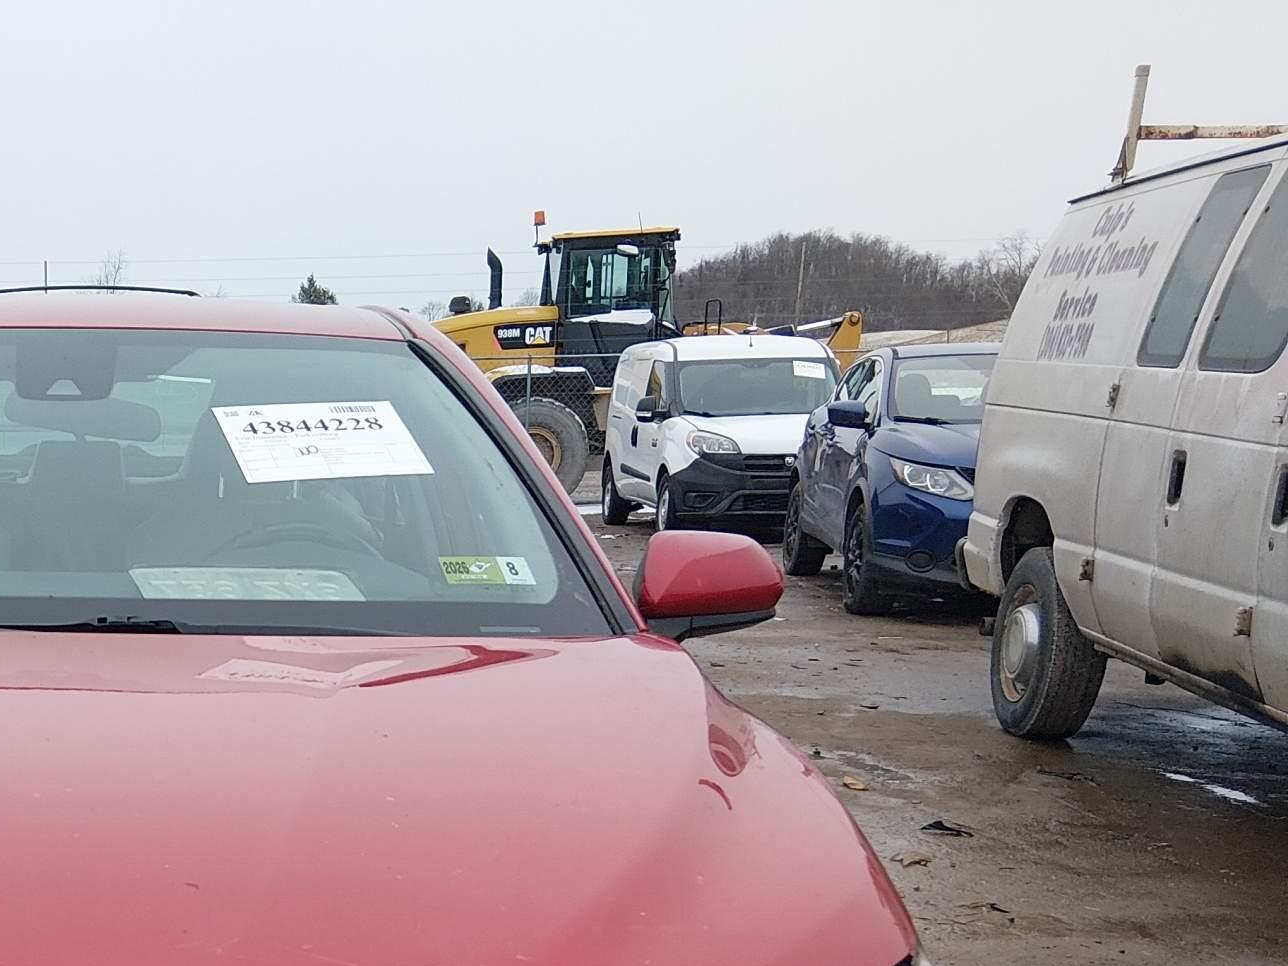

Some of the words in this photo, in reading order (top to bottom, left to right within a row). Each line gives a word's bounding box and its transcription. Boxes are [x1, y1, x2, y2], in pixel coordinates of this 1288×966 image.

[1096, 236, 1159, 279] Cleaning
[1053, 287, 1098, 322] Service
[525, 326, 553, 345] CAT
[243, 417, 383, 435] 43844228
[506, 561, 519, 576] 8
